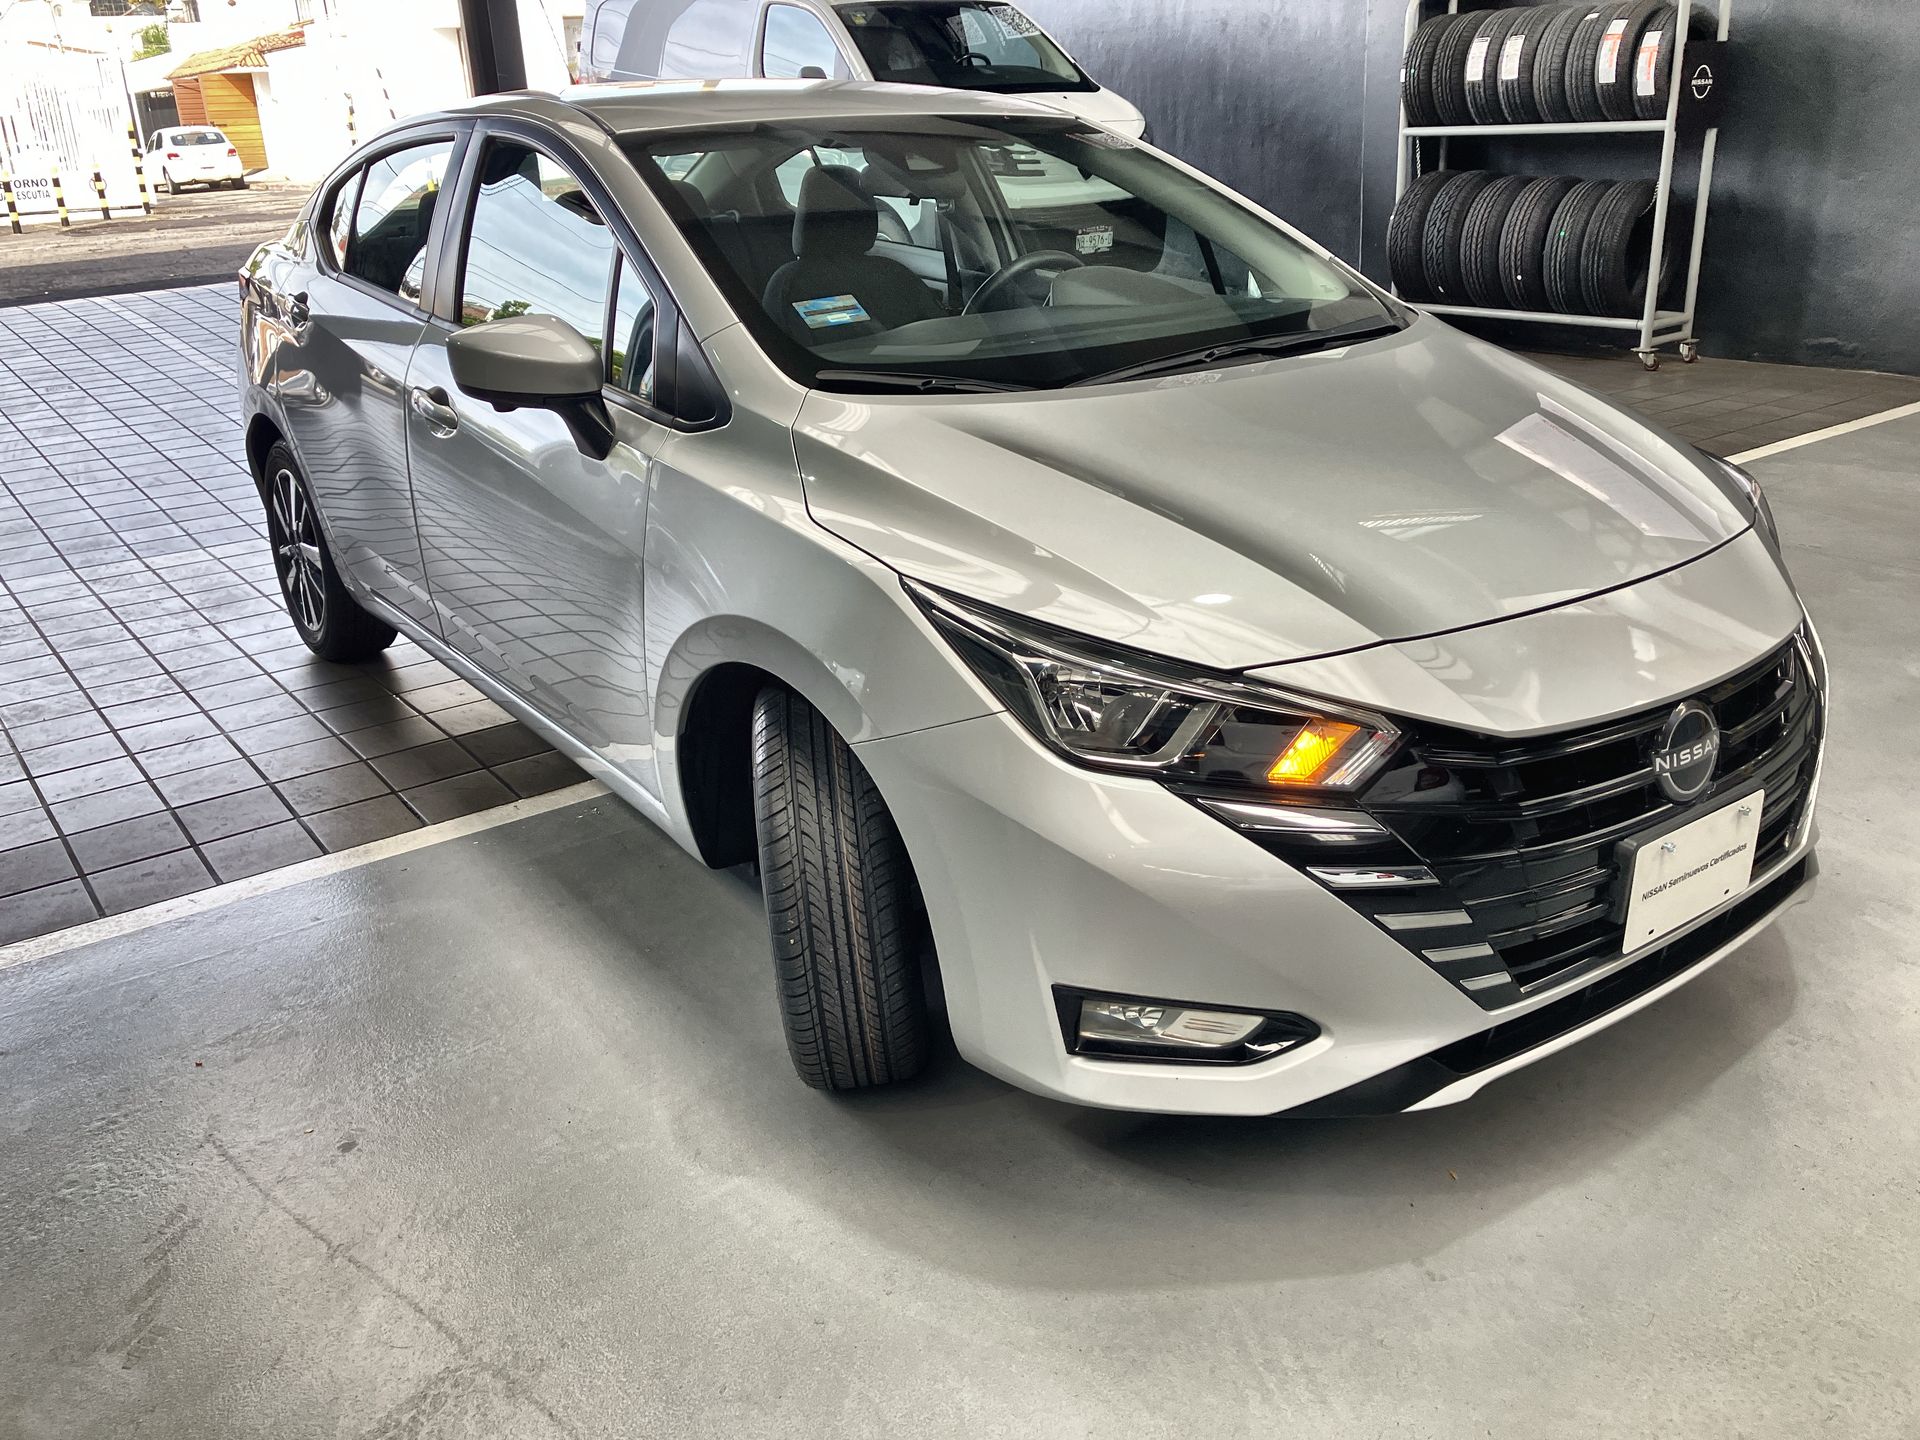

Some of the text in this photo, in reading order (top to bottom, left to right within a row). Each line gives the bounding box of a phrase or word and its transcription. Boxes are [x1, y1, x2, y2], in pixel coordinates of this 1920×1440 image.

[16, 189, 51, 200] ESCUTIA
[1656, 734, 1719, 771] NISSAN
[1642, 843, 1747, 901] NISSAN Seminuevos Certificados
